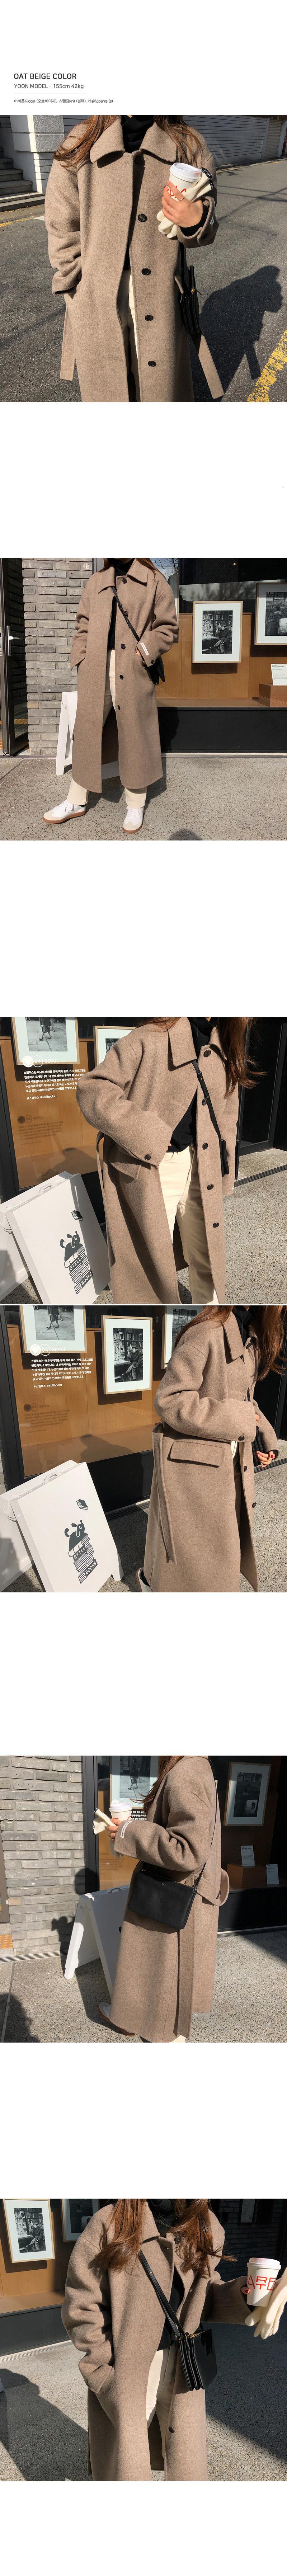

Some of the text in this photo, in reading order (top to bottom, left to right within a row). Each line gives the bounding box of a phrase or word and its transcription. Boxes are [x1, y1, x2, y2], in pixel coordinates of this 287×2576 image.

[69, 1258, 81, 1270] STILL
[81, 1272, 92, 1285] BOOKS
[74, 1547, 86, 1559] STILL
[85, 1561, 96, 1575] BOOKS
